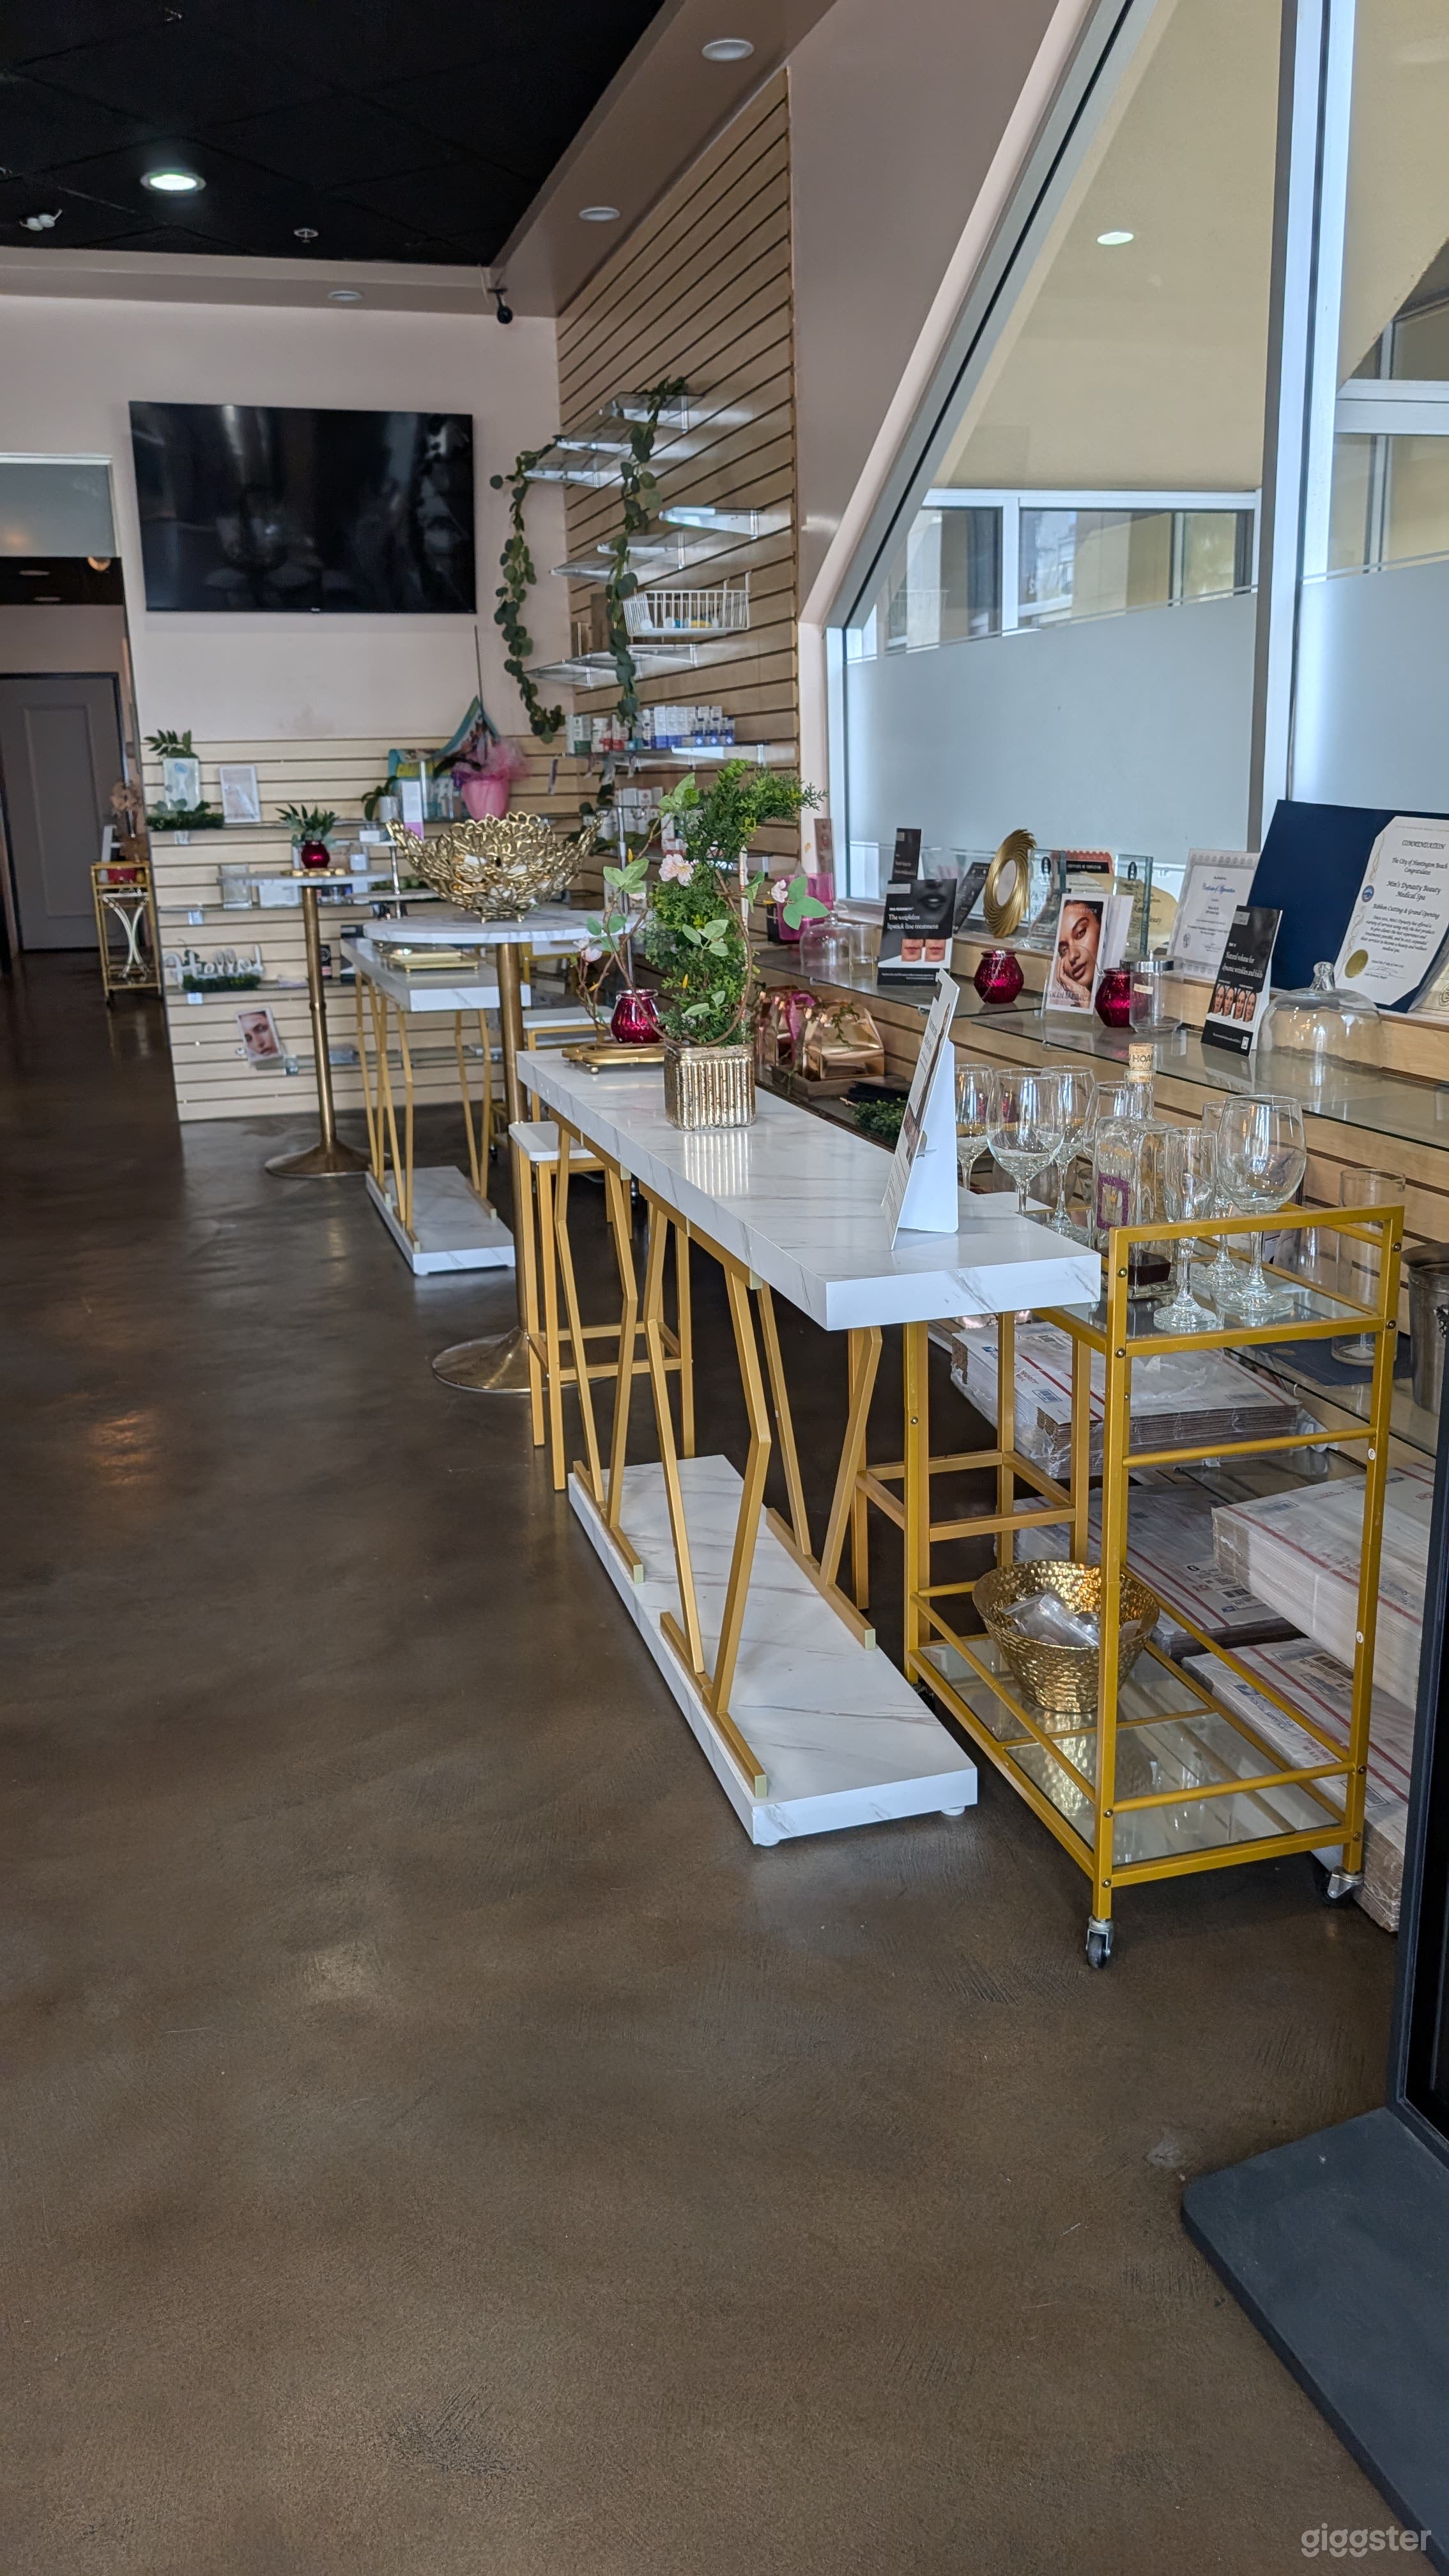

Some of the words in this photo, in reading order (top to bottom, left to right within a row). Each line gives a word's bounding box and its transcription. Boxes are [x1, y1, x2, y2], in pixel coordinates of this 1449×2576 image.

[1402, 839, 1446, 849] COMMENDATION
[1412, 860, 1435, 868] Huntington
[1404, 867, 1431, 875] Congratulates
[1402, 882, 1422, 893] Dynasty
[1423, 885, 1441, 894] Beauty
[1396, 891, 1416, 900] Medical
[1417, 893, 1425, 901] Spa
[1388, 905, 1403, 914] Cutting
[1422, 910, 1440, 919] Opening
[1303, 1737, 1338, 1763] PRIORIT
